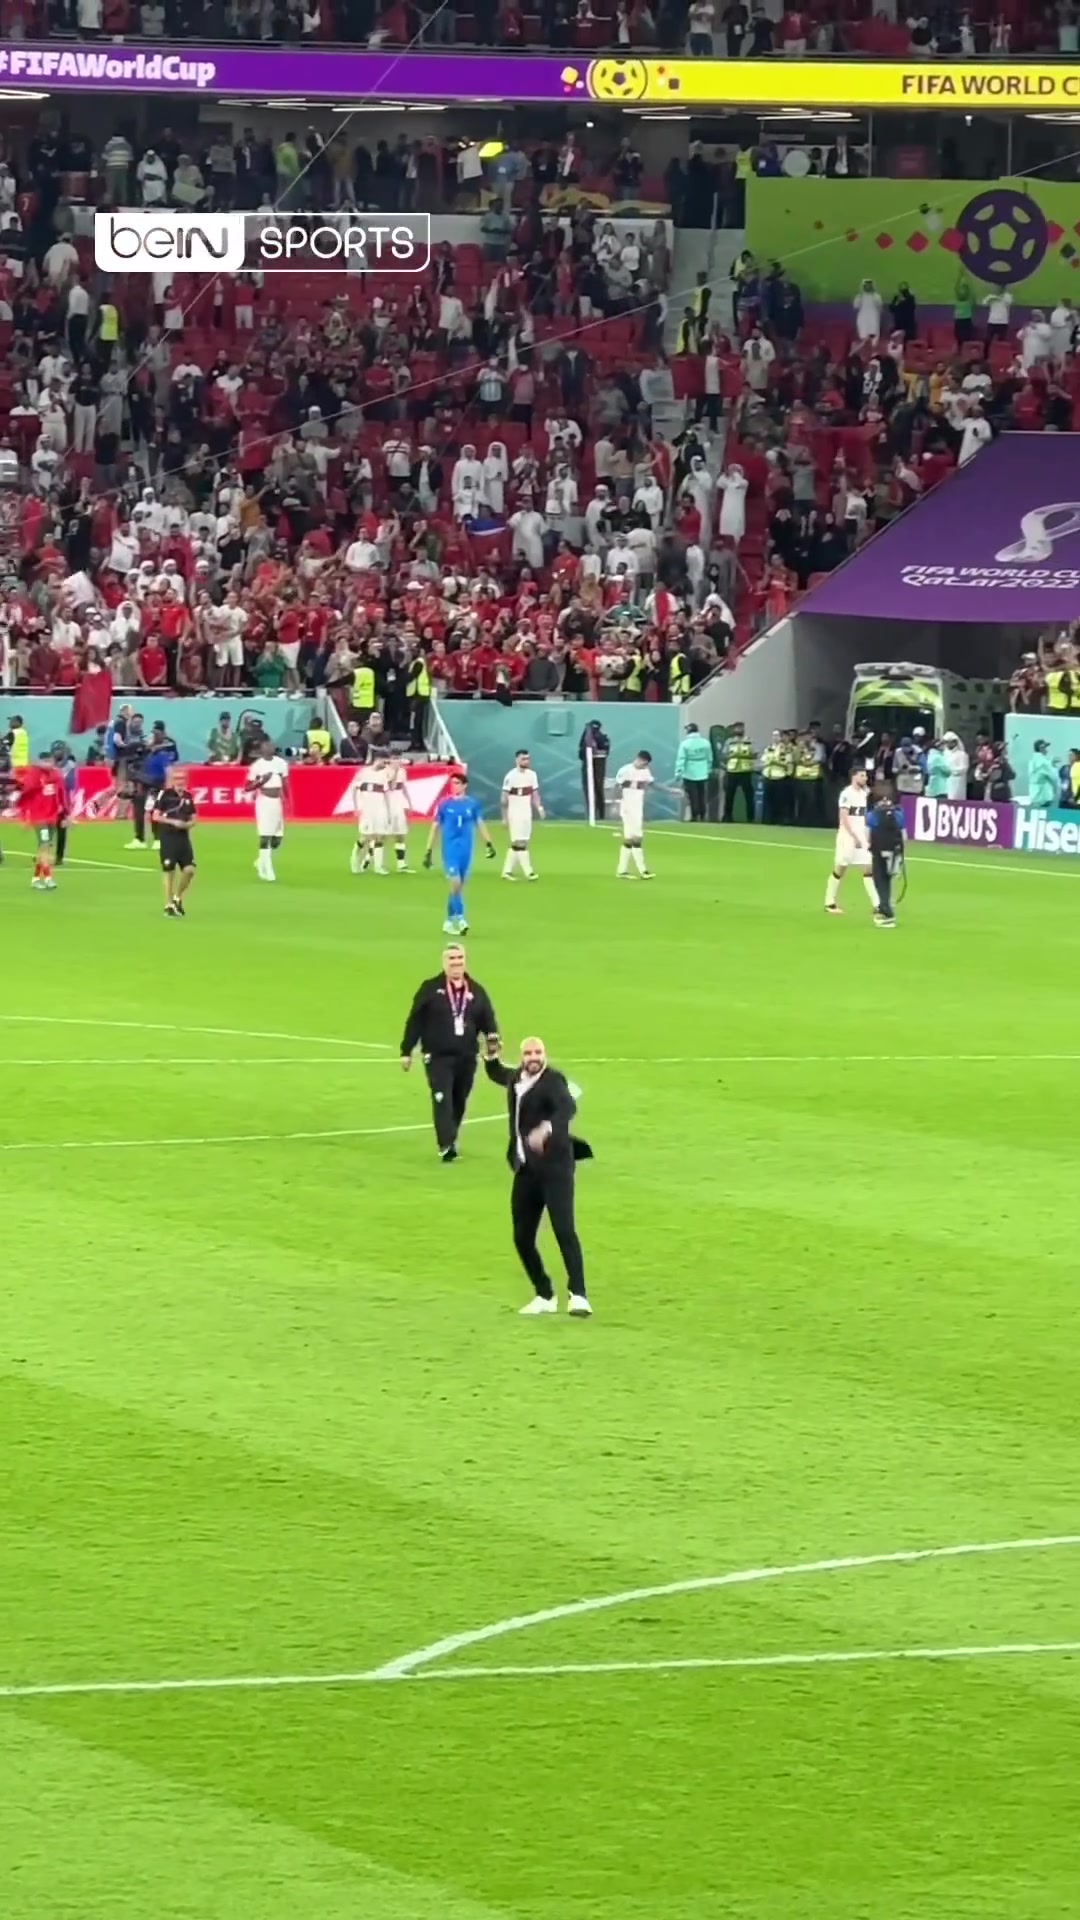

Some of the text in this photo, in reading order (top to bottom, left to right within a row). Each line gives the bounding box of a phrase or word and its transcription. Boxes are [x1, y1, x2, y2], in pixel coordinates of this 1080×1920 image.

[902, 75, 956, 94] FIFA
[961, 75, 1056, 96] WORLD
[901, 565, 956, 575] FIFA
[959, 567, 1051, 578] WORLD
[937, 803, 998, 842] BYJU'S
[1014, 807, 1080, 854] Hise
